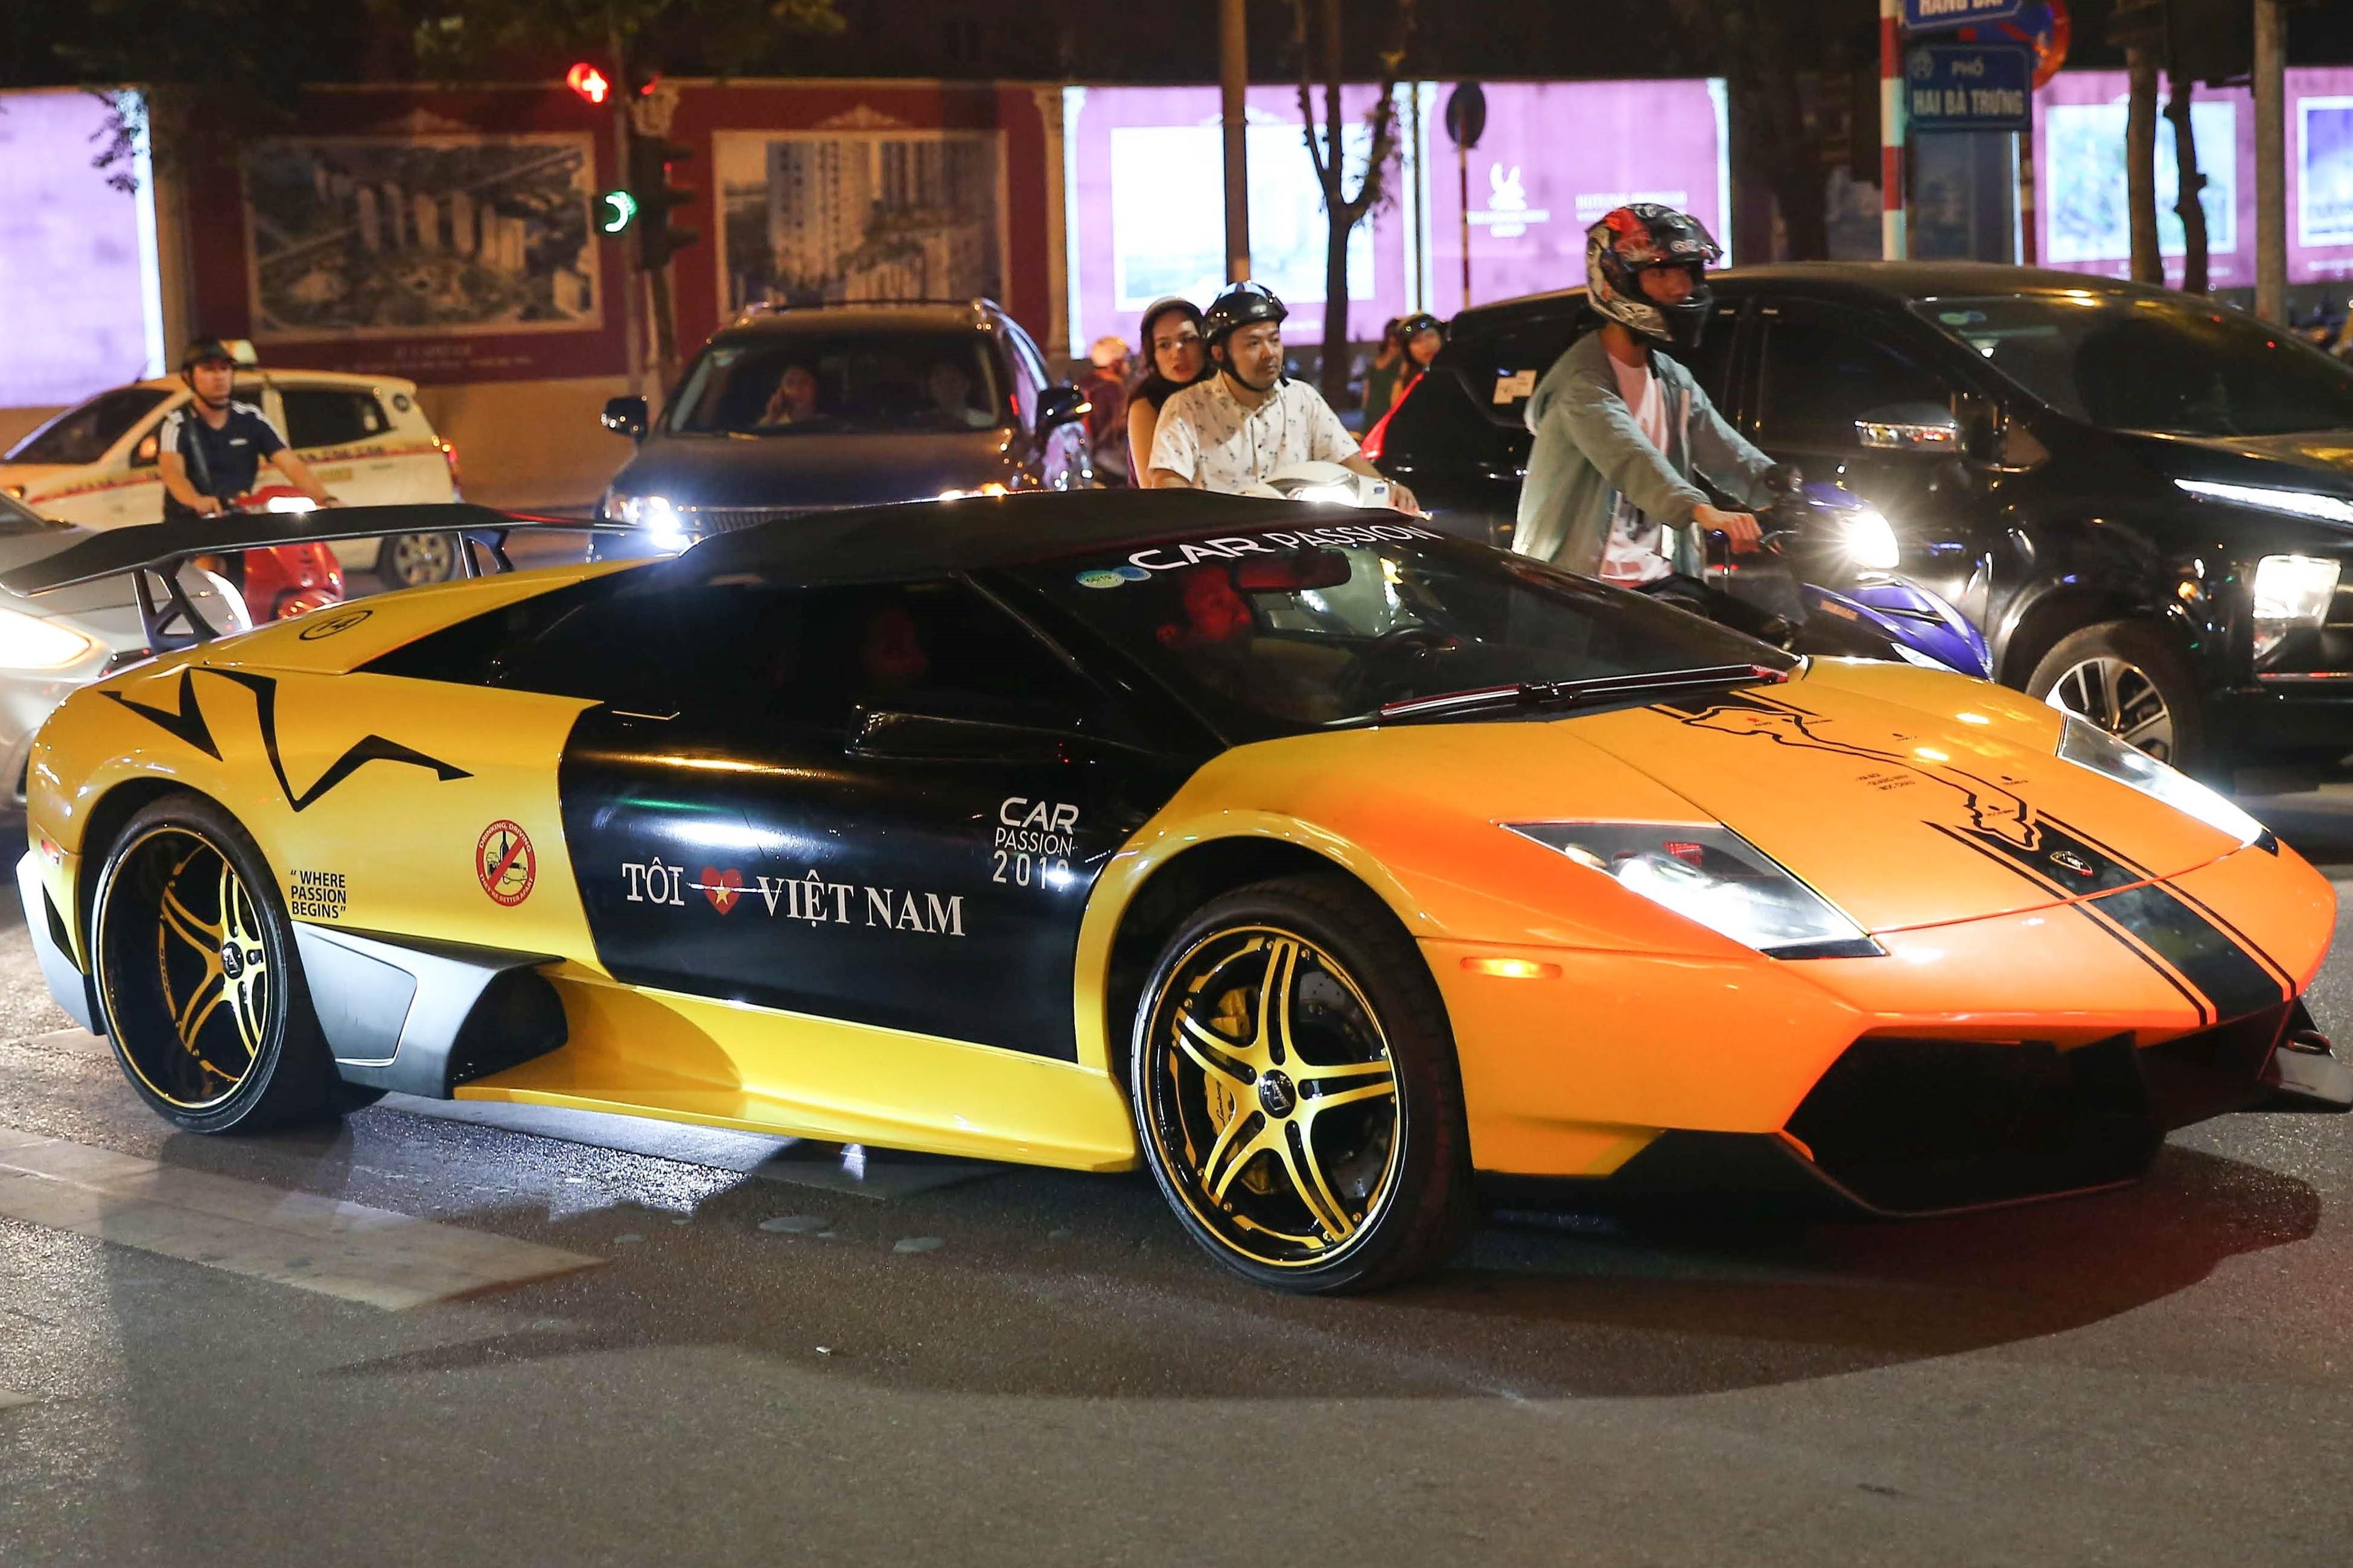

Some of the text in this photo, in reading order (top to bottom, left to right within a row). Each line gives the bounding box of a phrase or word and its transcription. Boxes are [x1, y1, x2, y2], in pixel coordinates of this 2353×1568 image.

[1913, 90, 1941, 115] HAI
[1129, 524, 1445, 570] CAR PASSION
[1000, 797, 1079, 834] CAR
[995, 827, 1072, 857] PASSION
[291, 885, 346, 904] PASSION
[622, 857, 966, 936] TÔI VIỆT NAM
